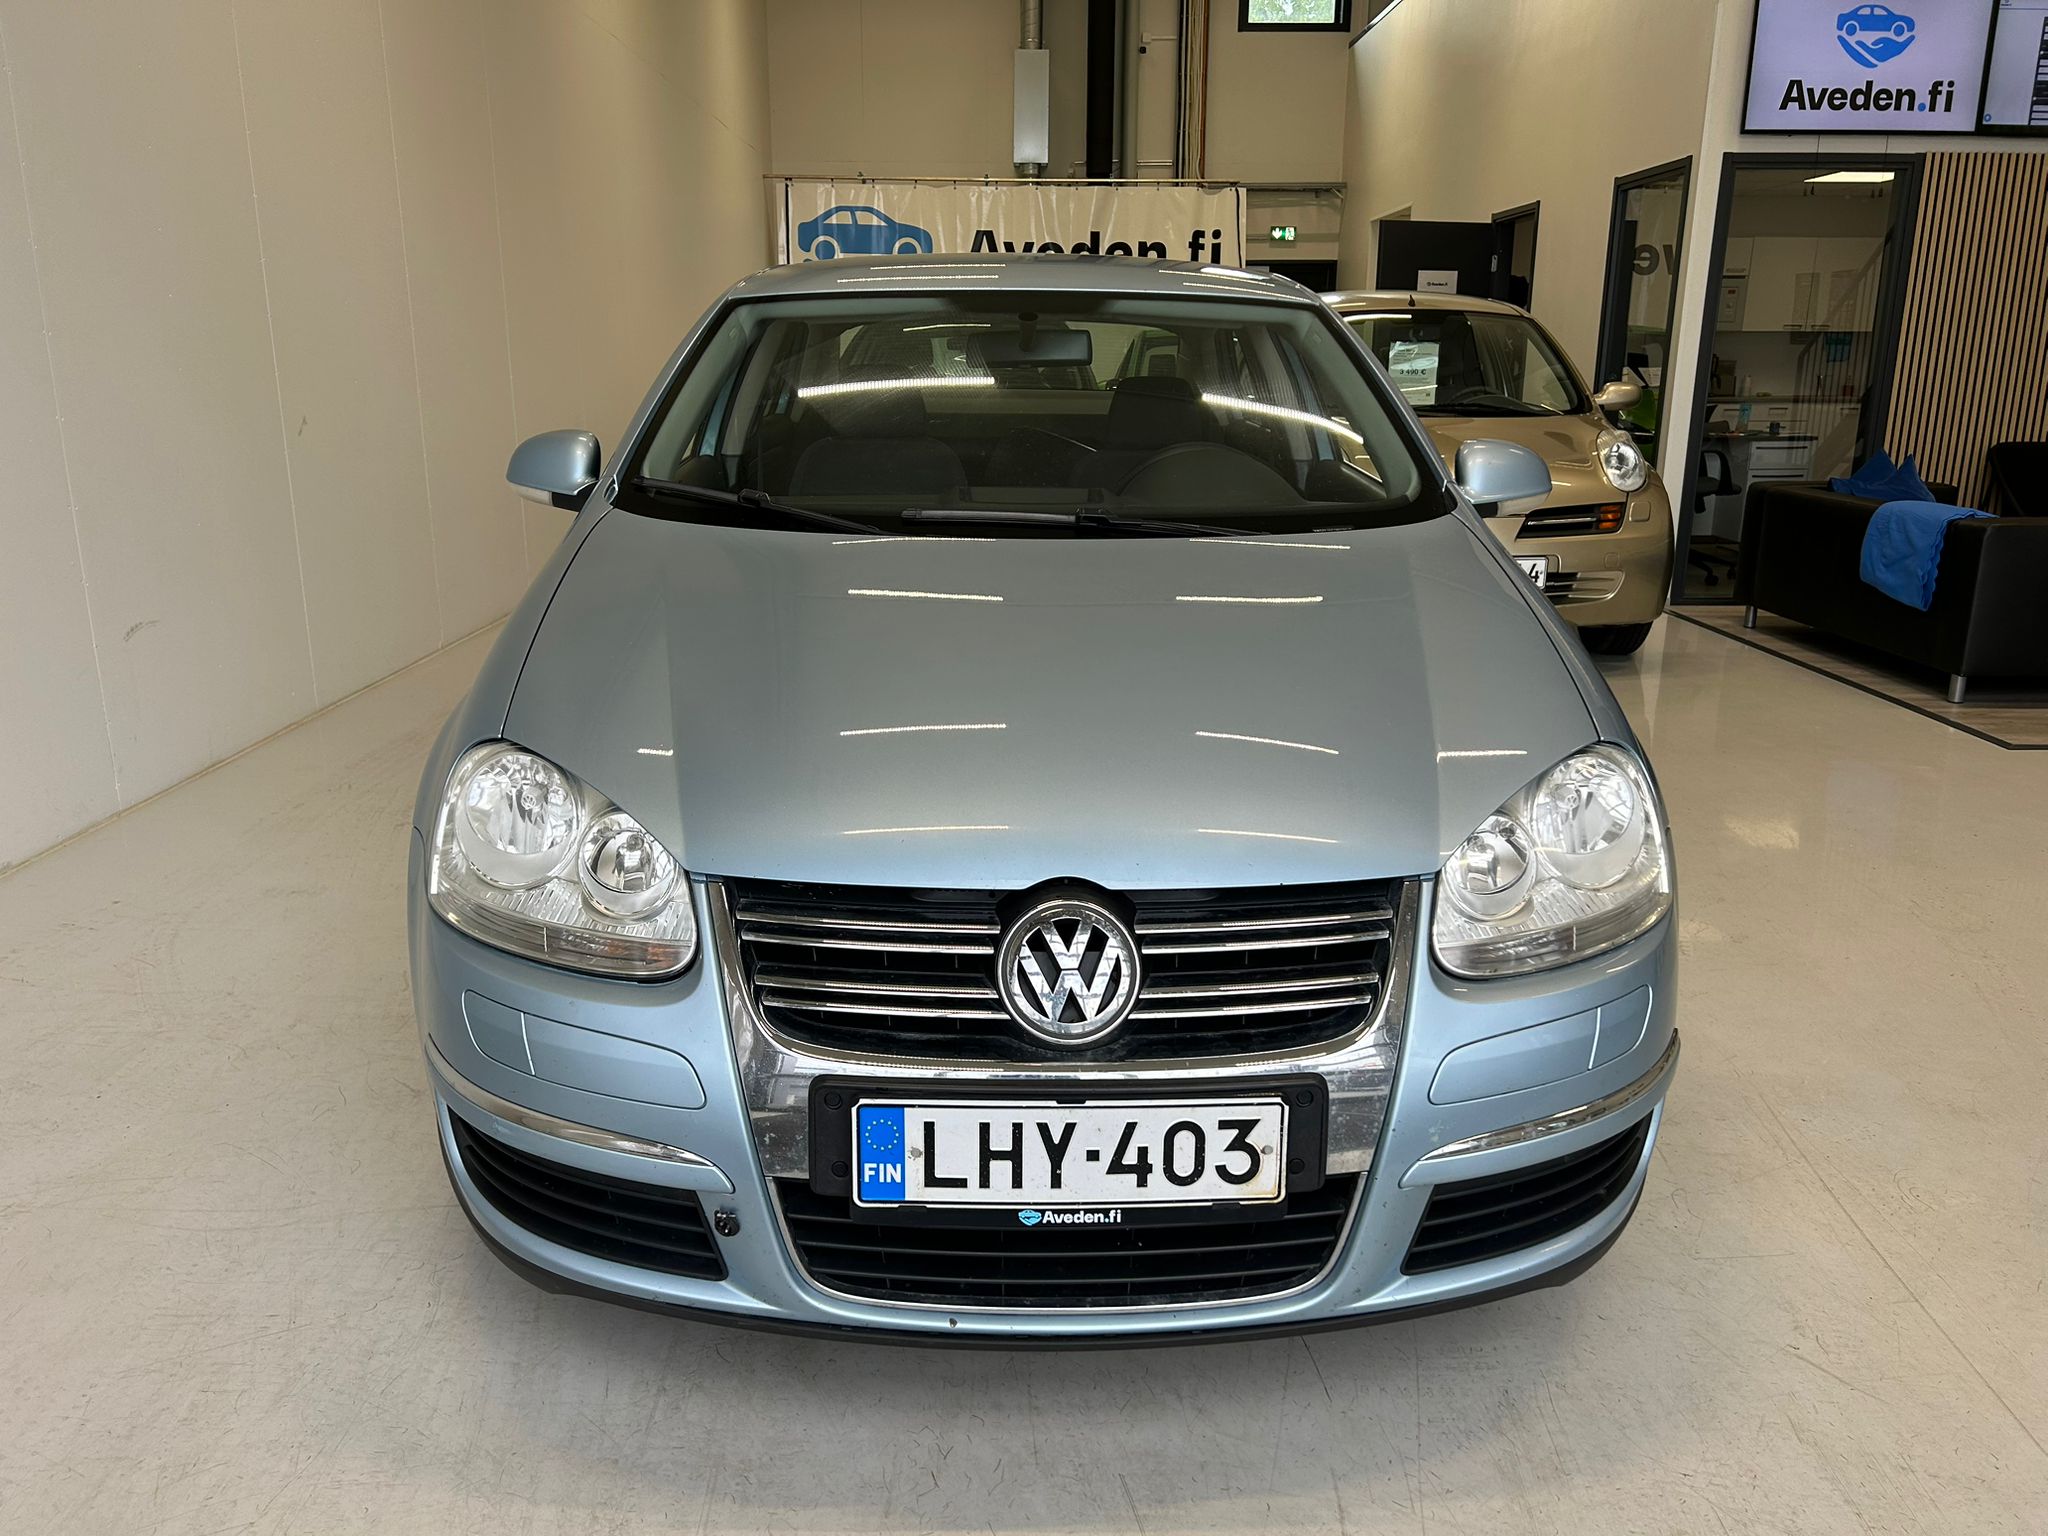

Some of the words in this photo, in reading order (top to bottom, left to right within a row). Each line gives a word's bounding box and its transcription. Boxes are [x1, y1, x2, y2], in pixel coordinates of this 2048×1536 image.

[1778, 79, 1955, 112] Aveden.fi
[923, 1119, 1262, 1188] LHY-403
[863, 1164, 902, 1184] FIN
[1042, 1209, 1122, 1224] Aveden.fi
